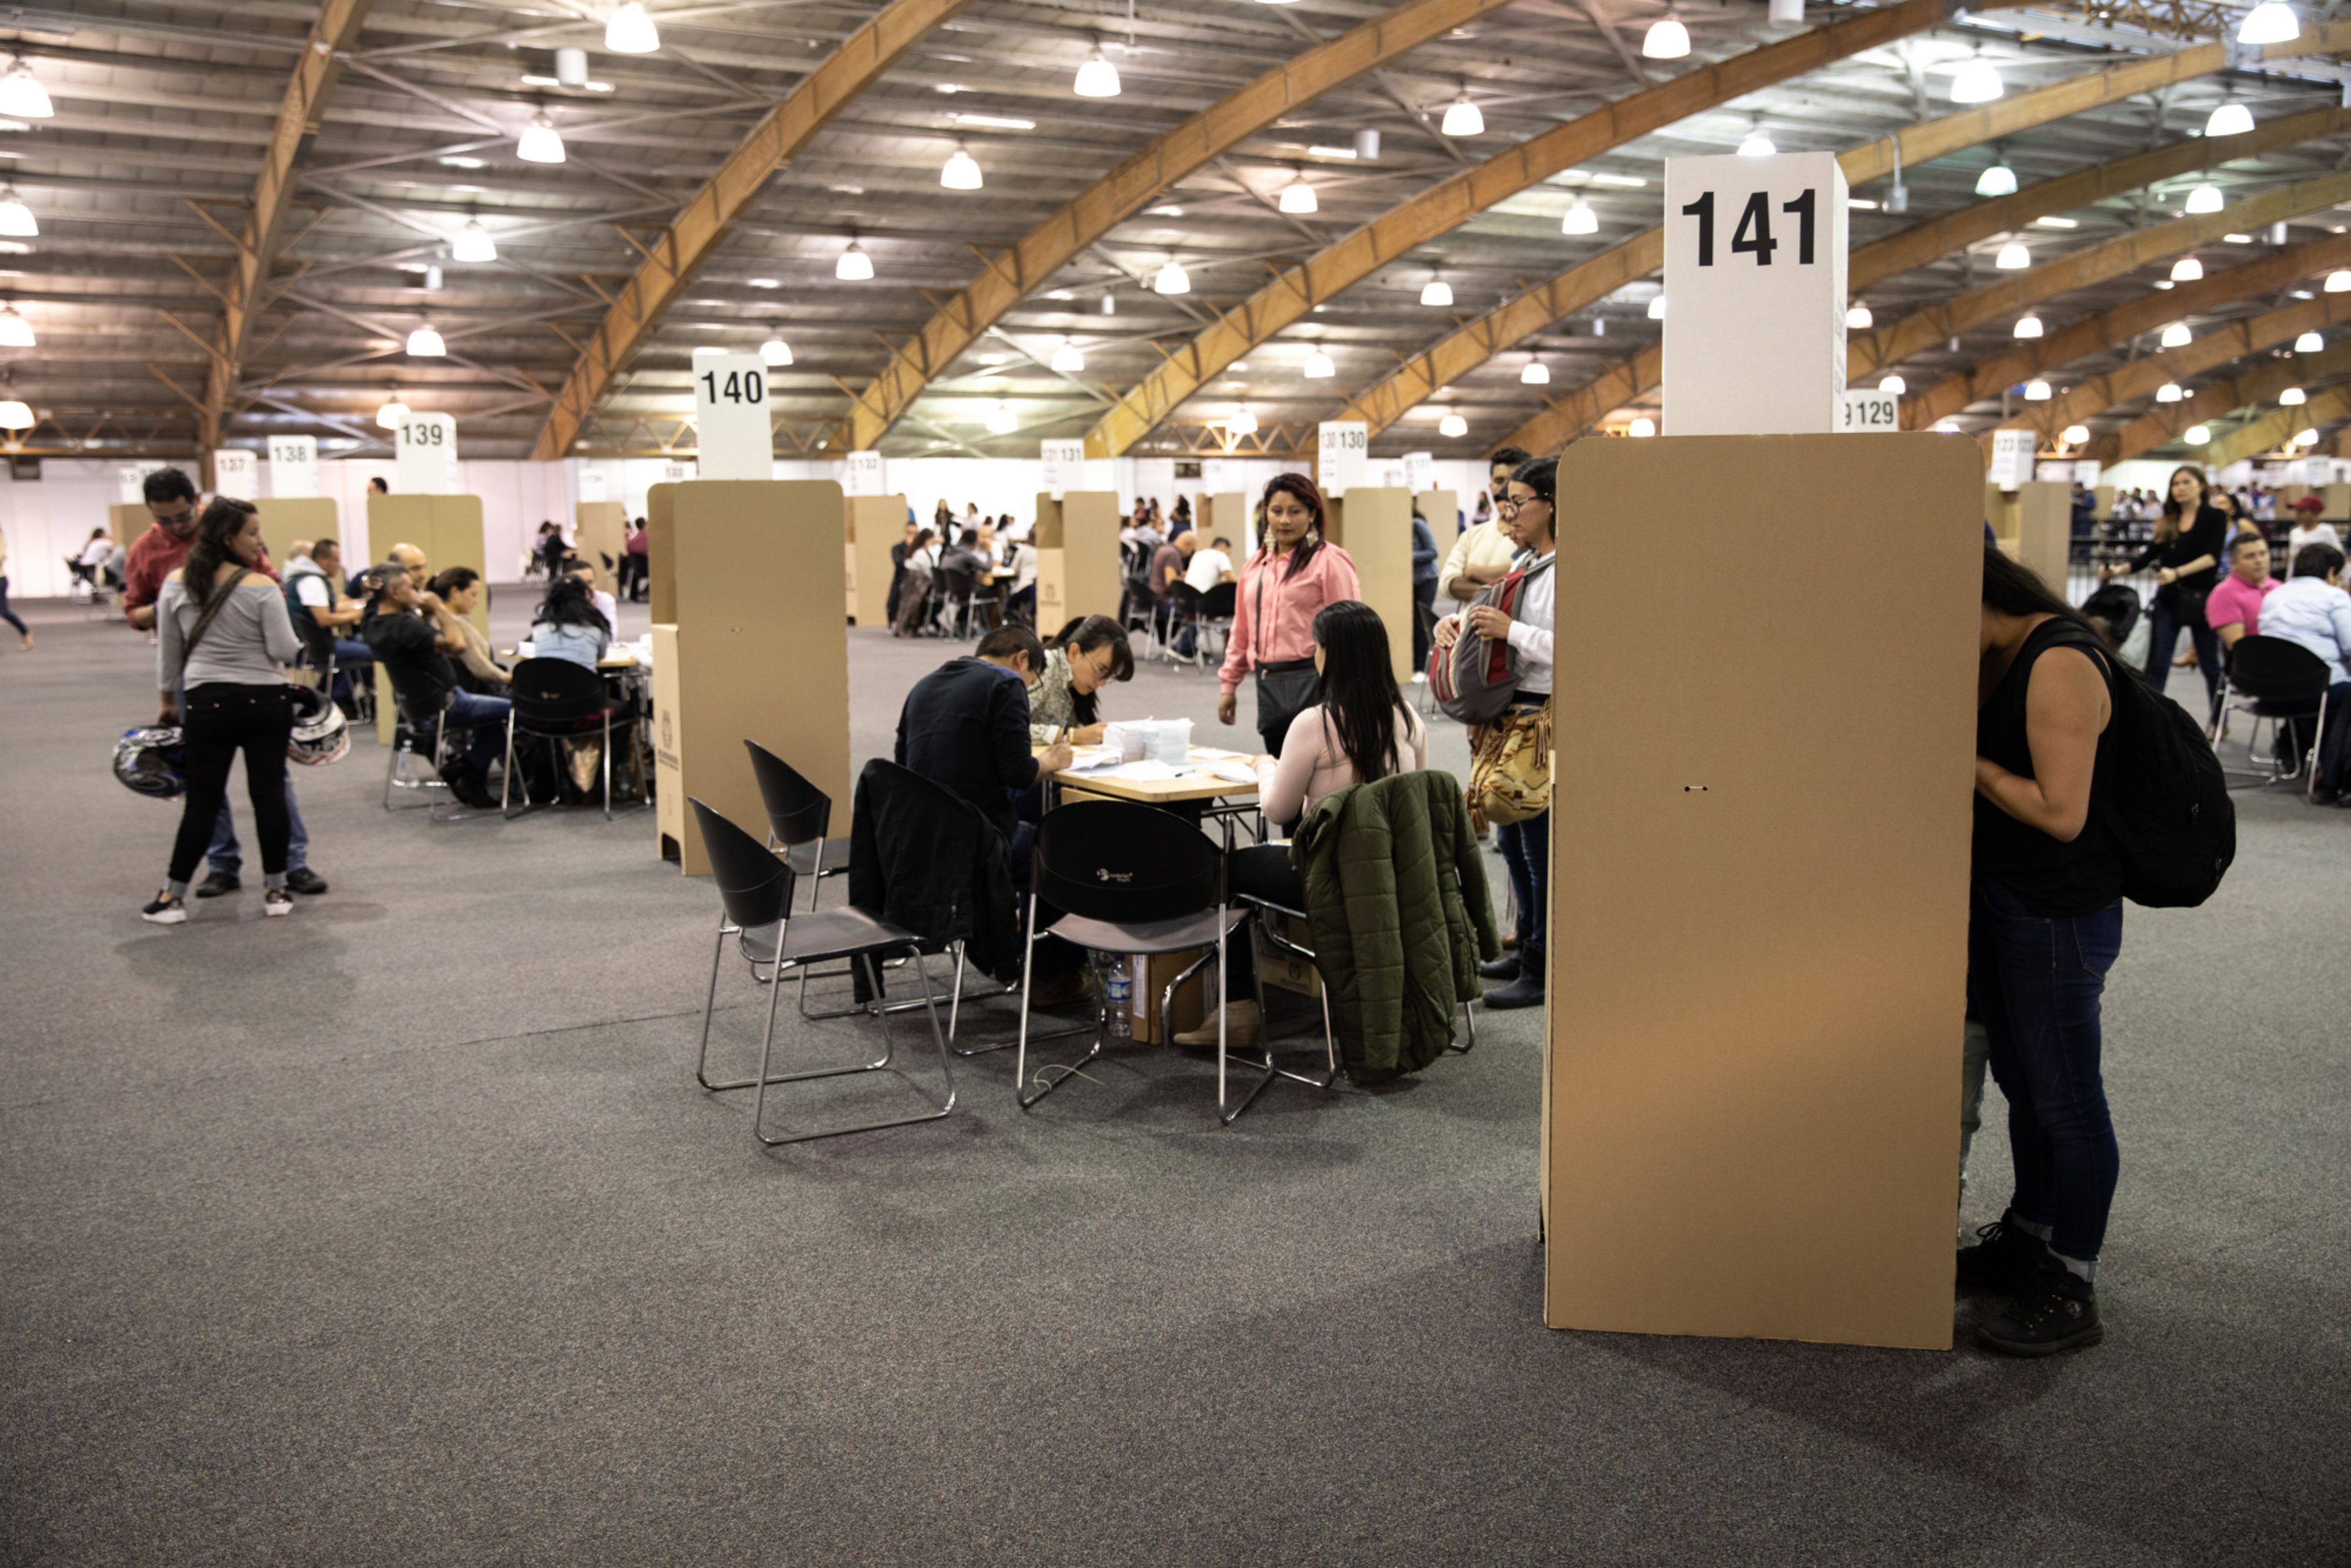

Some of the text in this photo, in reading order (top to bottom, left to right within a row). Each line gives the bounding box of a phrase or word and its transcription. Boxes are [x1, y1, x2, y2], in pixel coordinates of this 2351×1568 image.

[1682, 189, 1815, 266] 141
[701, 370, 763, 404] 140
[1856, 401, 1894, 424] 129
[402, 423, 443, 446] 139
[1340, 431, 1365, 449] 130
[275, 446, 306, 463] 138
